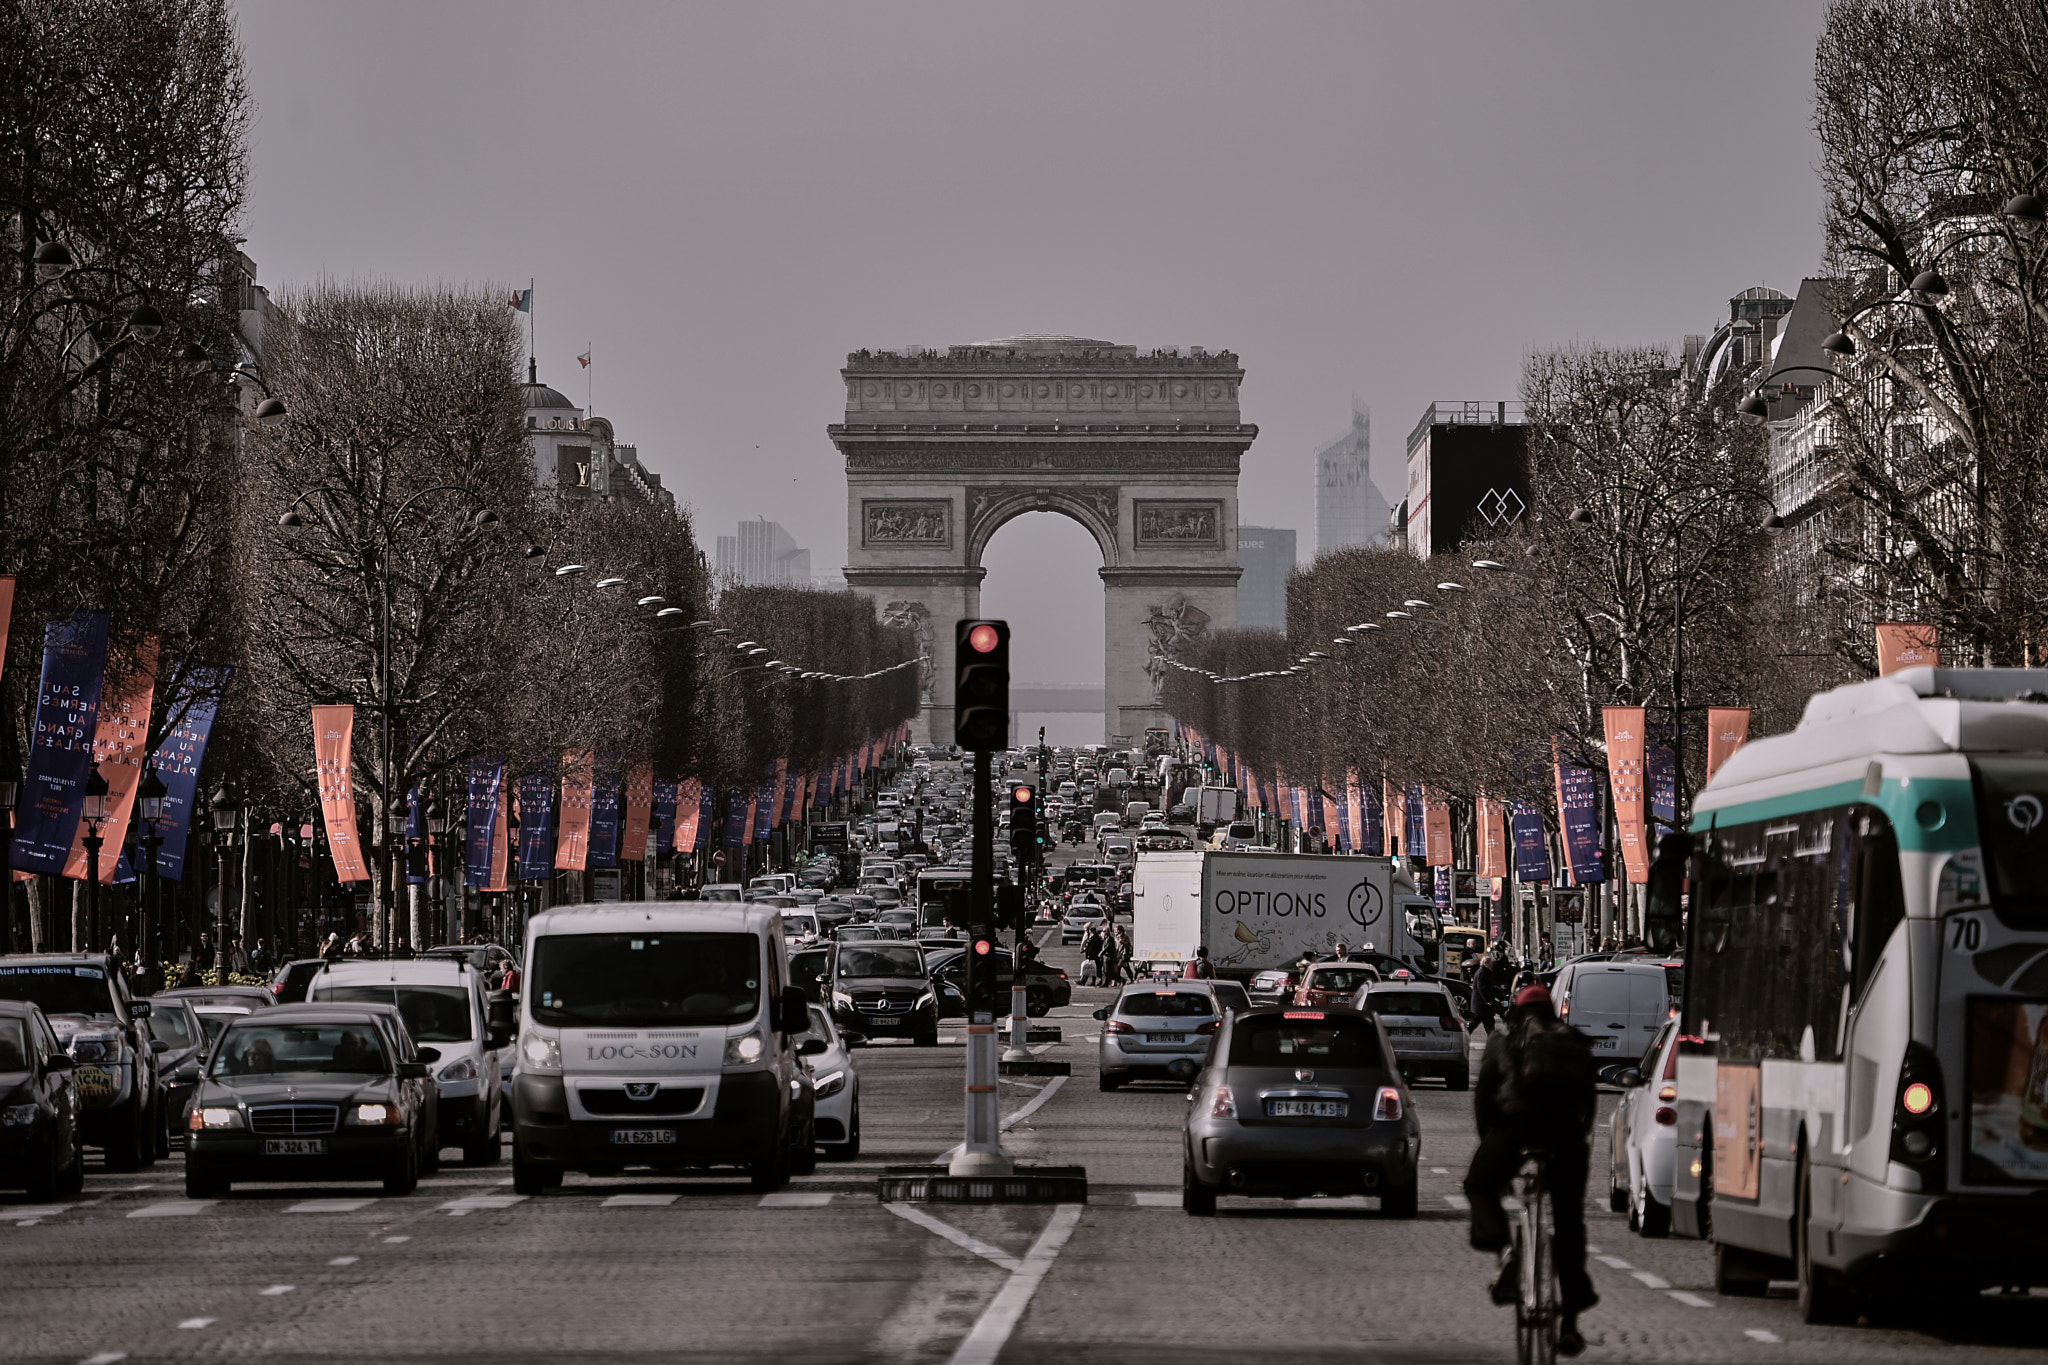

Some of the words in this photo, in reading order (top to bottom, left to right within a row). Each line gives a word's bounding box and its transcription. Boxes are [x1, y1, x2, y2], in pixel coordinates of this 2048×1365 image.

[542, 419, 574, 431] LOUIS
[1216, 890, 1327, 917] OPTIONS
[1953, 918, 1980, 951] 70
[17, 967, 29, 975] les
[32, 966, 72, 975] opticiens
[131, 1003, 149, 1015] gan
[267, 1141, 320, 1153] DN-324-YL
